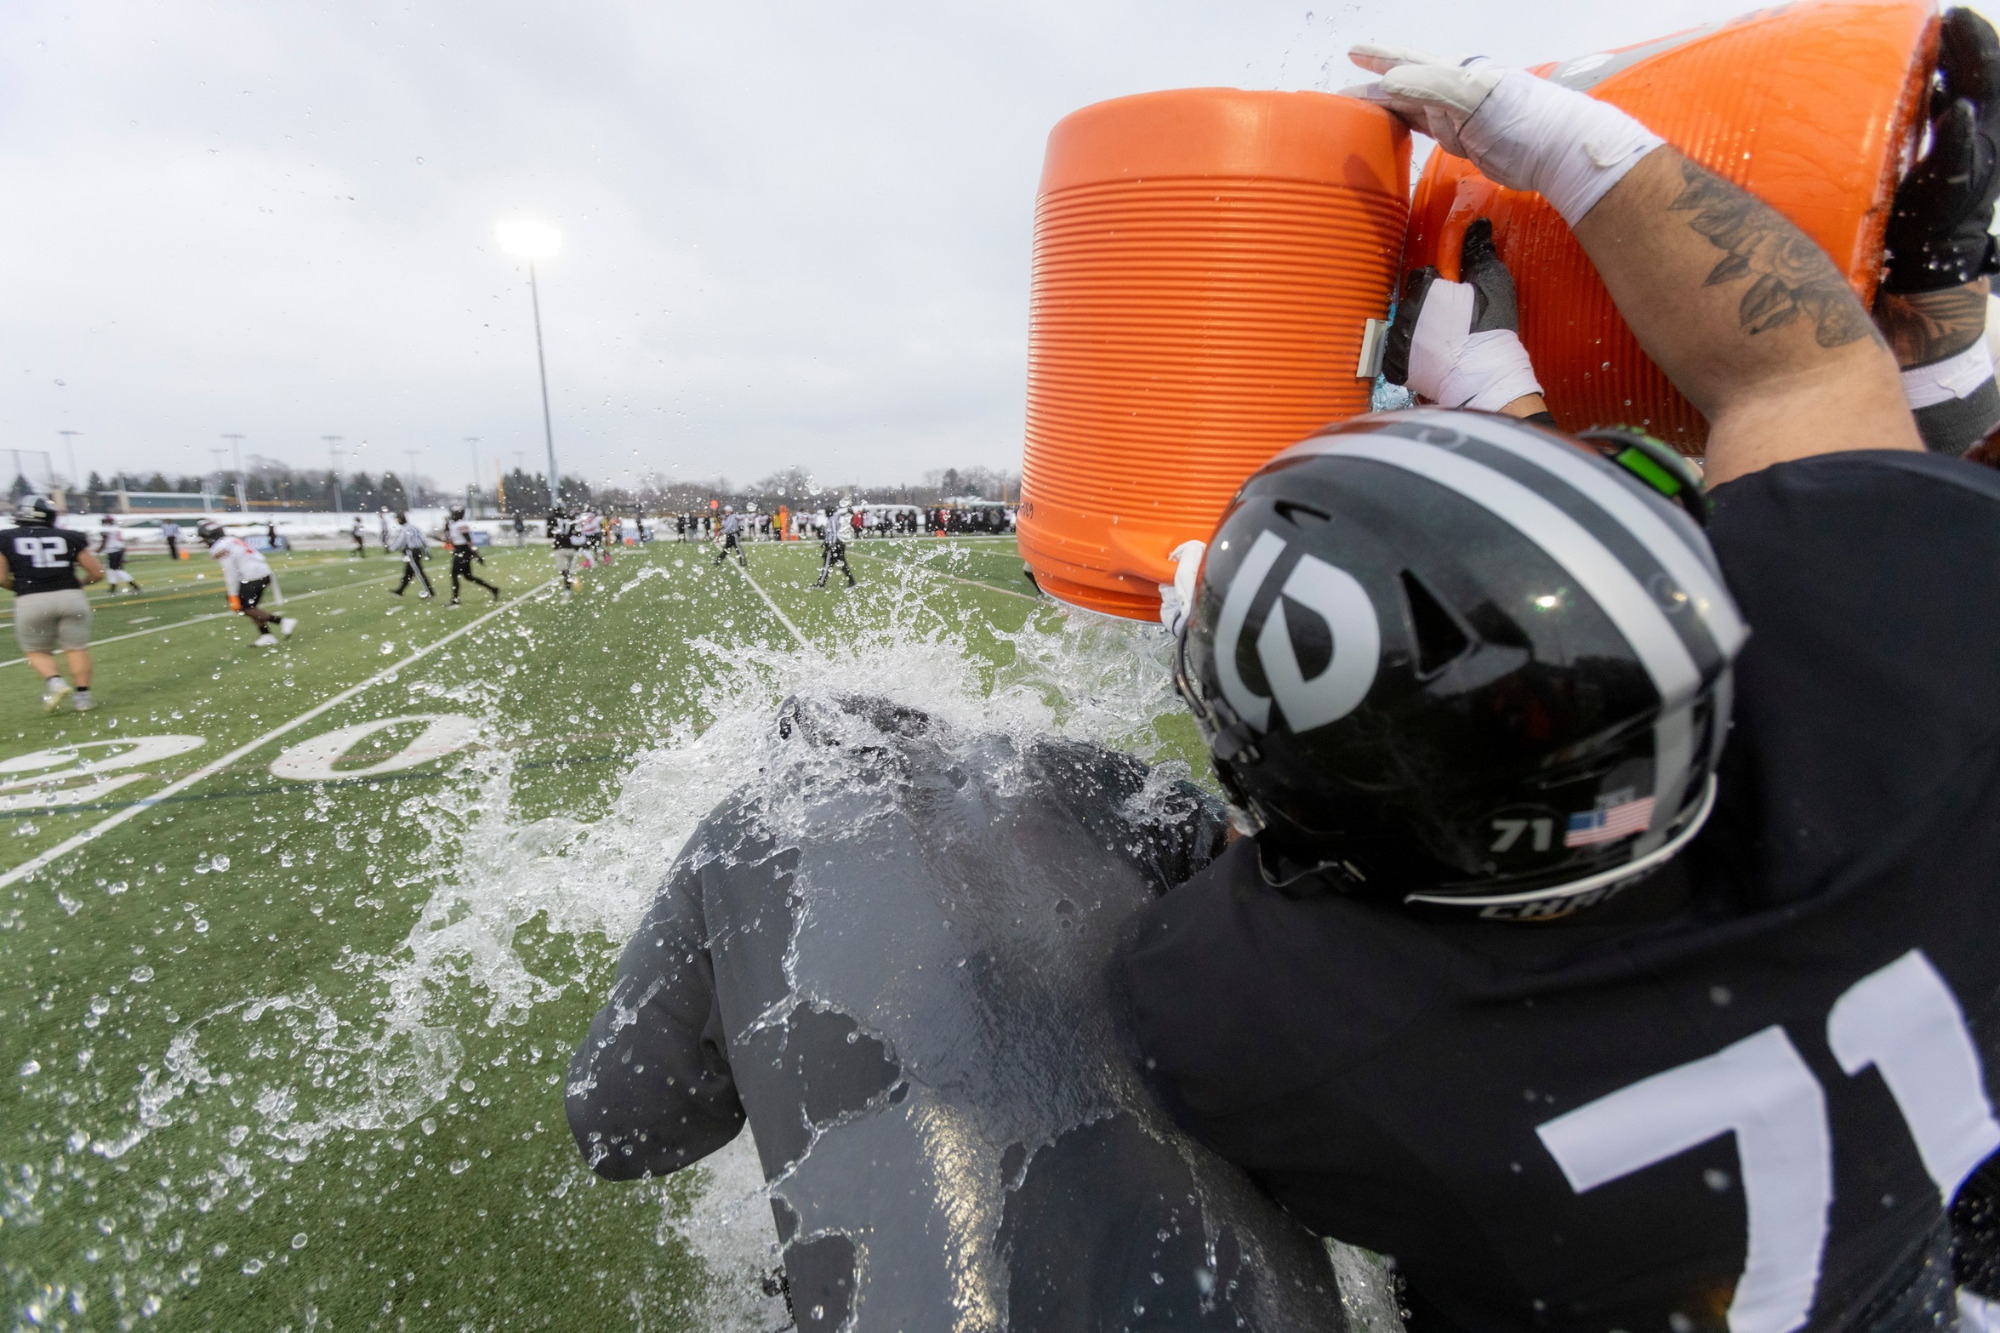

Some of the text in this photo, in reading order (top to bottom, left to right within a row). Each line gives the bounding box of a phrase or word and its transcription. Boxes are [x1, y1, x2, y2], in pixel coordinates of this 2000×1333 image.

[14, 536, 70, 568] 92
[1490, 819, 1553, 852] 71
[1535, 948, 2000, 1333] 71
